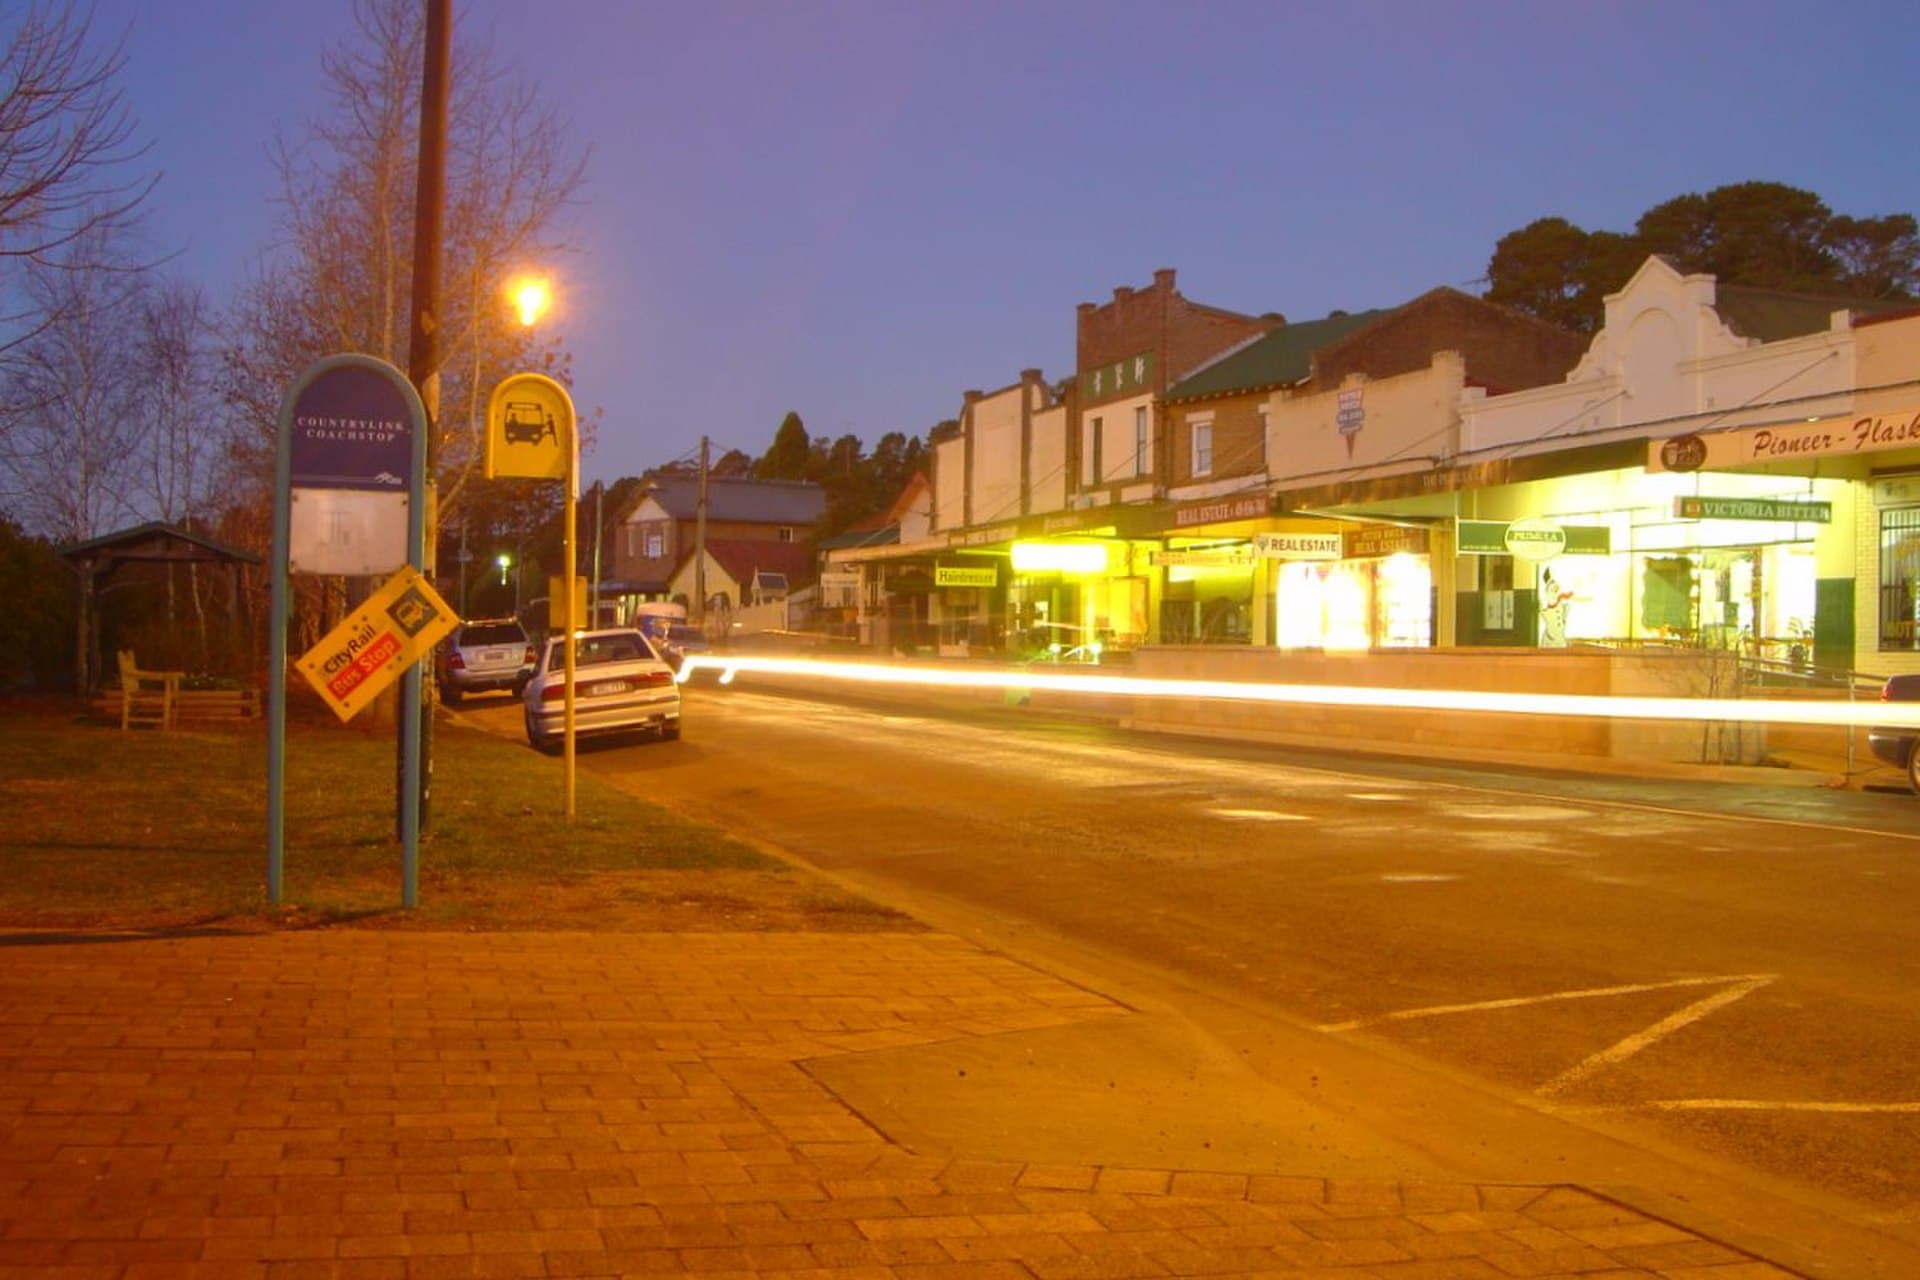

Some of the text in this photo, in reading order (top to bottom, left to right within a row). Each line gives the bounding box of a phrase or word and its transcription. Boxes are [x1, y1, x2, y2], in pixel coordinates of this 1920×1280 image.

[297, 417, 404, 431] COUNTRYLINK
[306, 428, 396, 441] COACHSTOP
[1753, 430, 1832, 458] Pioneer
[1704, 502, 1829, 520] VICTORIA BITTER
[1271, 538, 1337, 553] REAL ESTATE
[323, 624, 376, 674] CityRail
[333, 640, 395, 694] Bus Stop
